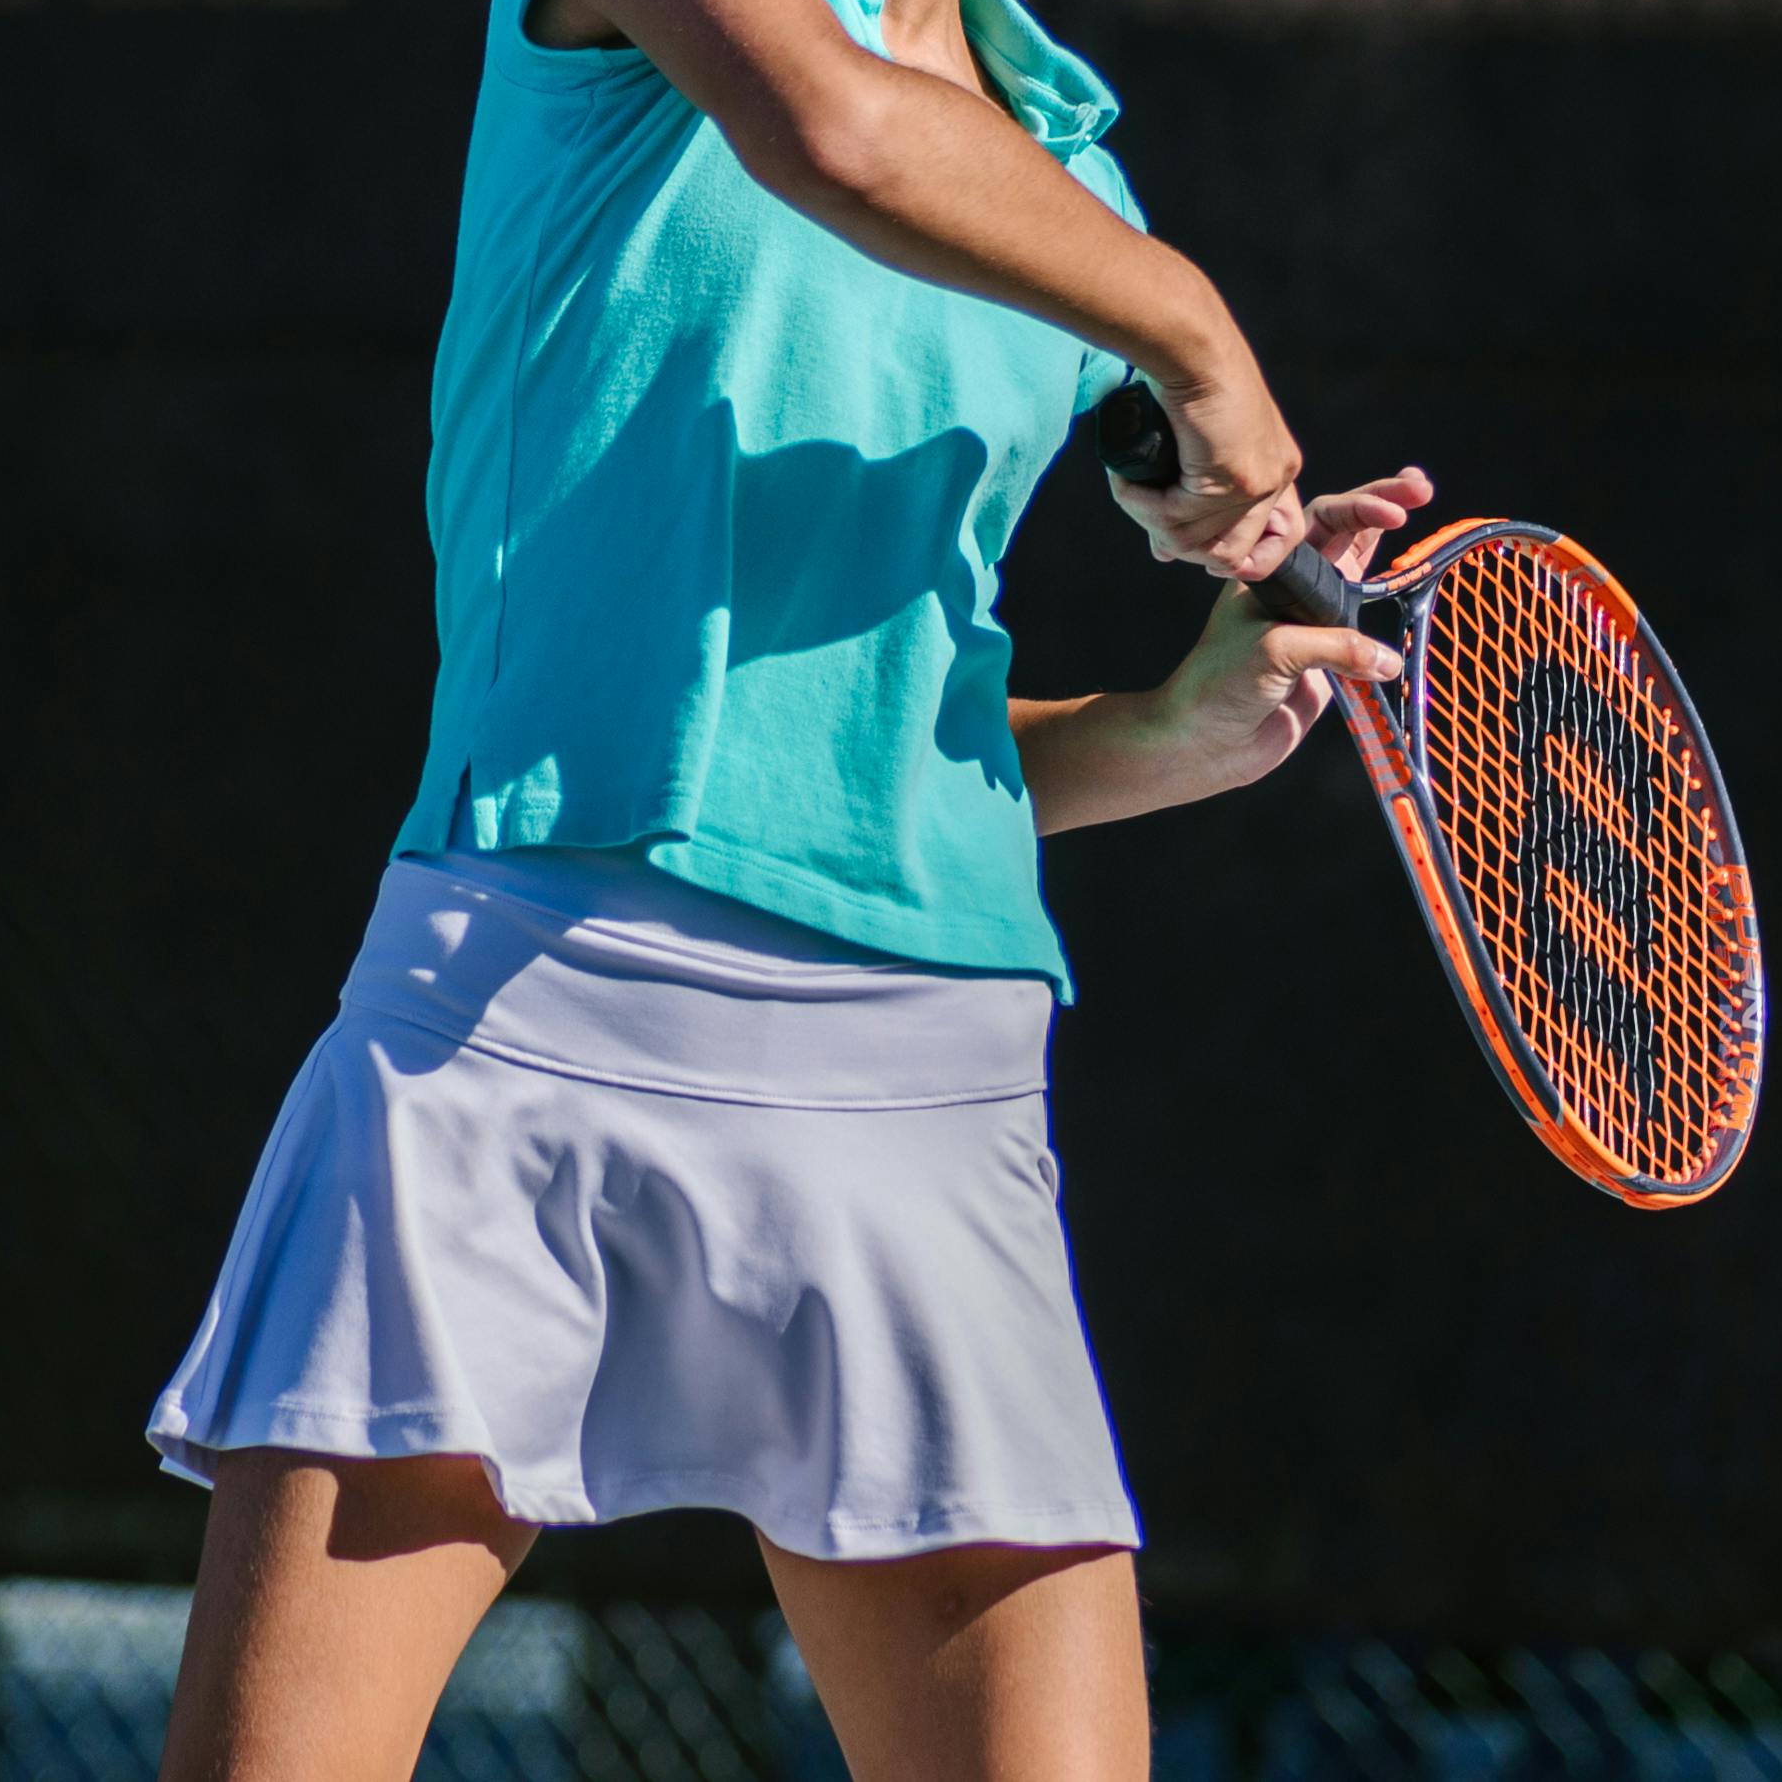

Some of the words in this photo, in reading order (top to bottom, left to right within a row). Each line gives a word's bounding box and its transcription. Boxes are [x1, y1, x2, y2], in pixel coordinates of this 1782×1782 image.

[1335, 673, 1413, 795] Wilso
[1725, 864, 1762, 1029] BURN
[1726, 1040, 1761, 1133] TEAM
